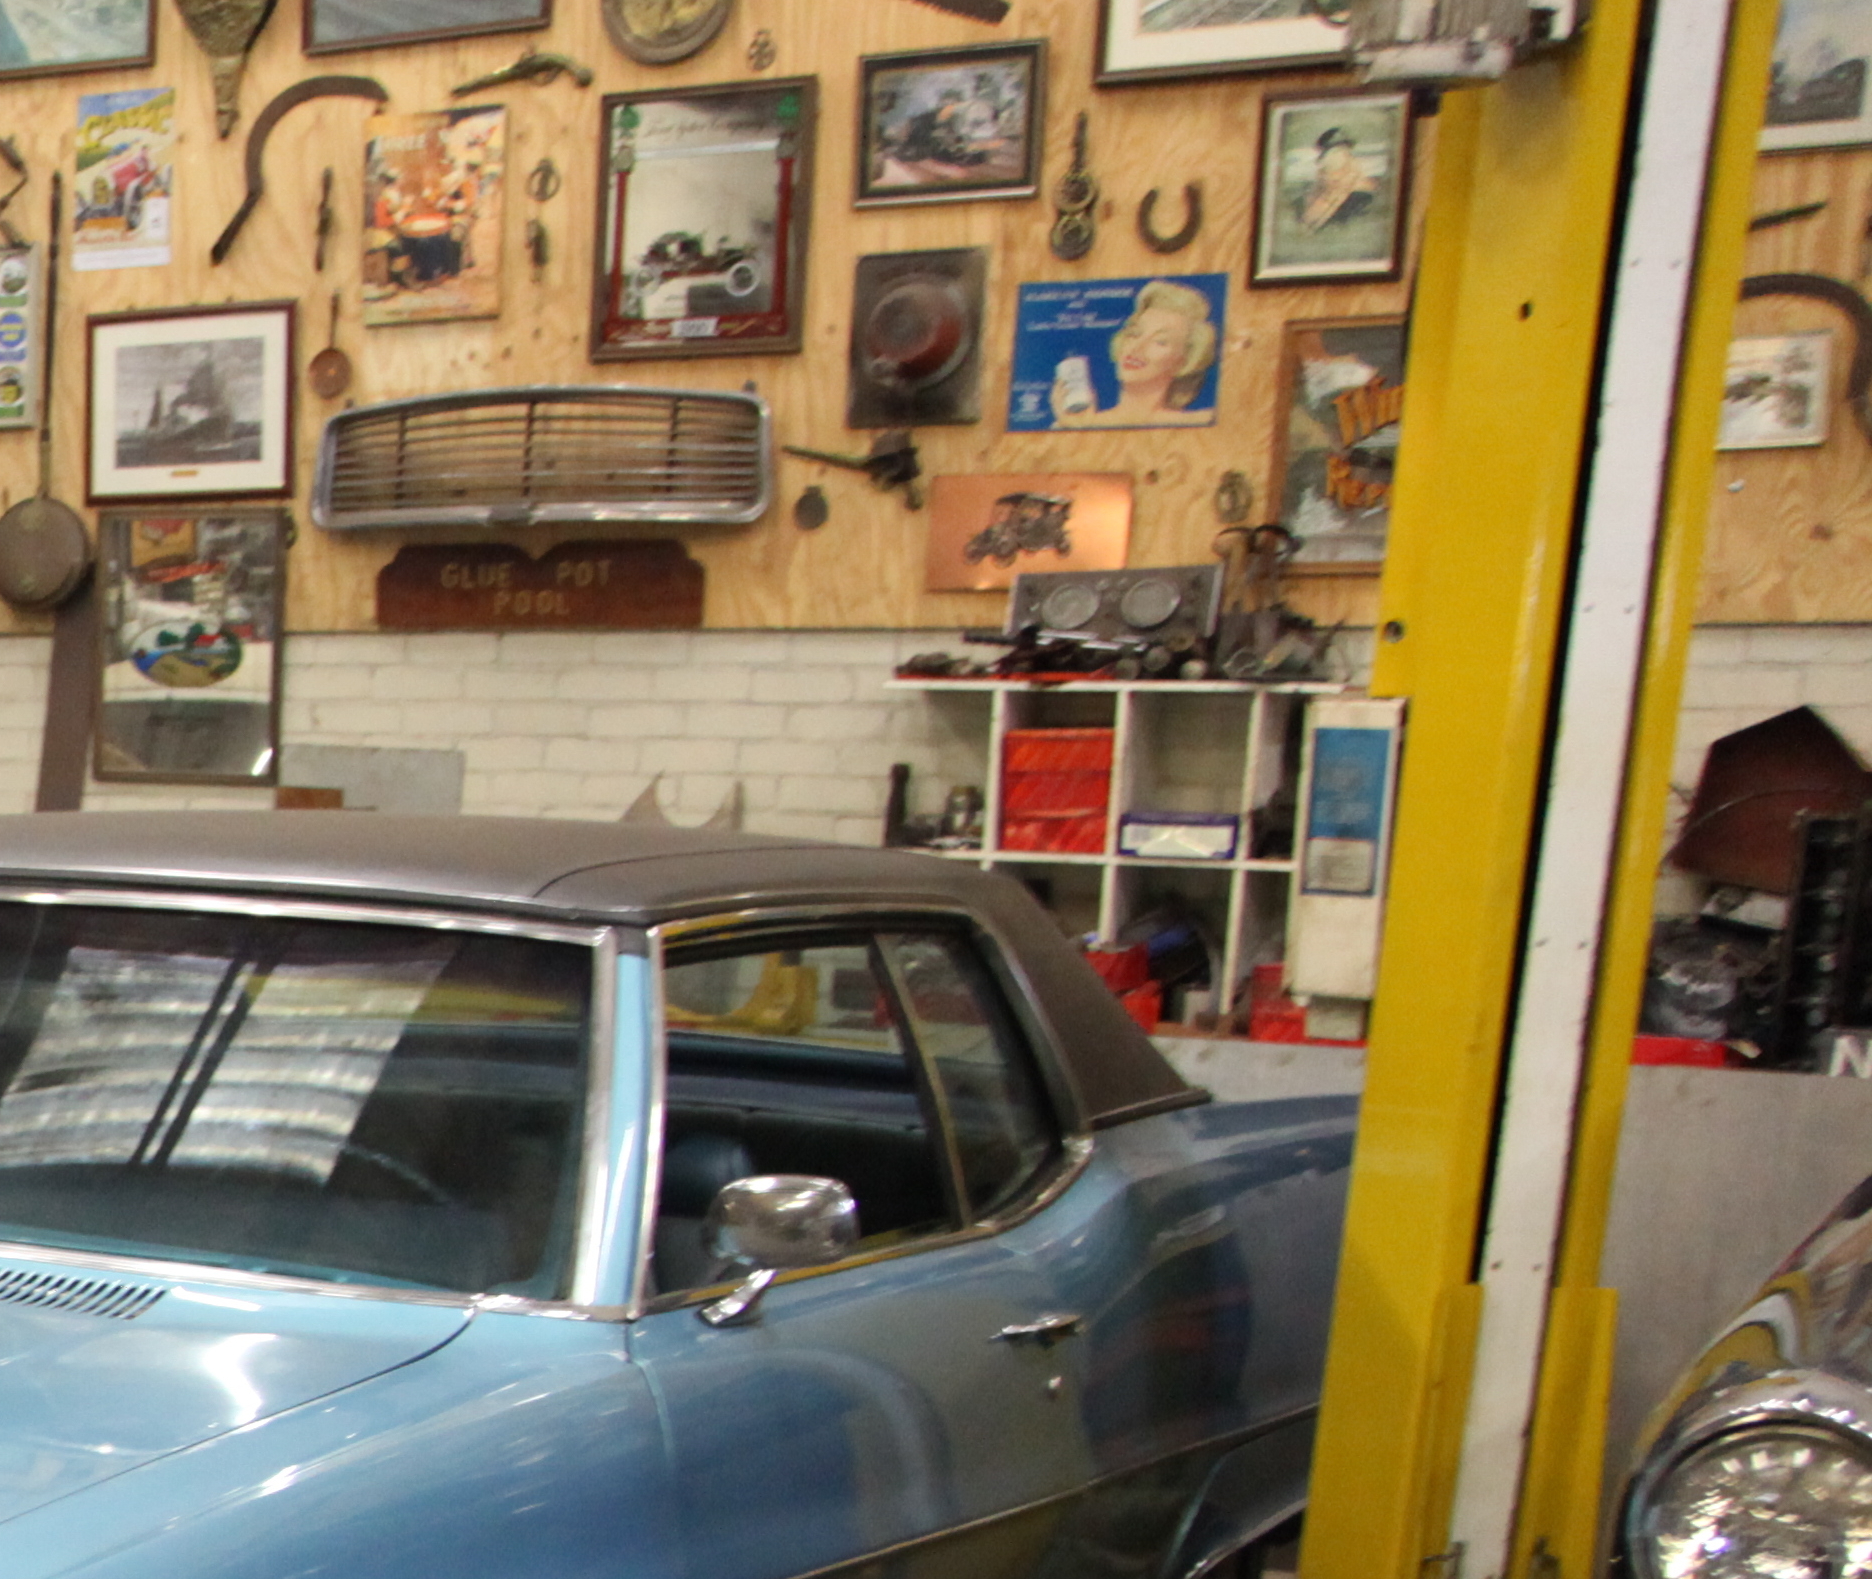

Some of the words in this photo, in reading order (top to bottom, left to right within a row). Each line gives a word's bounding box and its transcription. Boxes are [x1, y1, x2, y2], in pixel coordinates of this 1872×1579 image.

[440, 560, 514, 588] GLUE
[556, 558, 614, 588] POT
[492, 588, 571, 616] POOL
